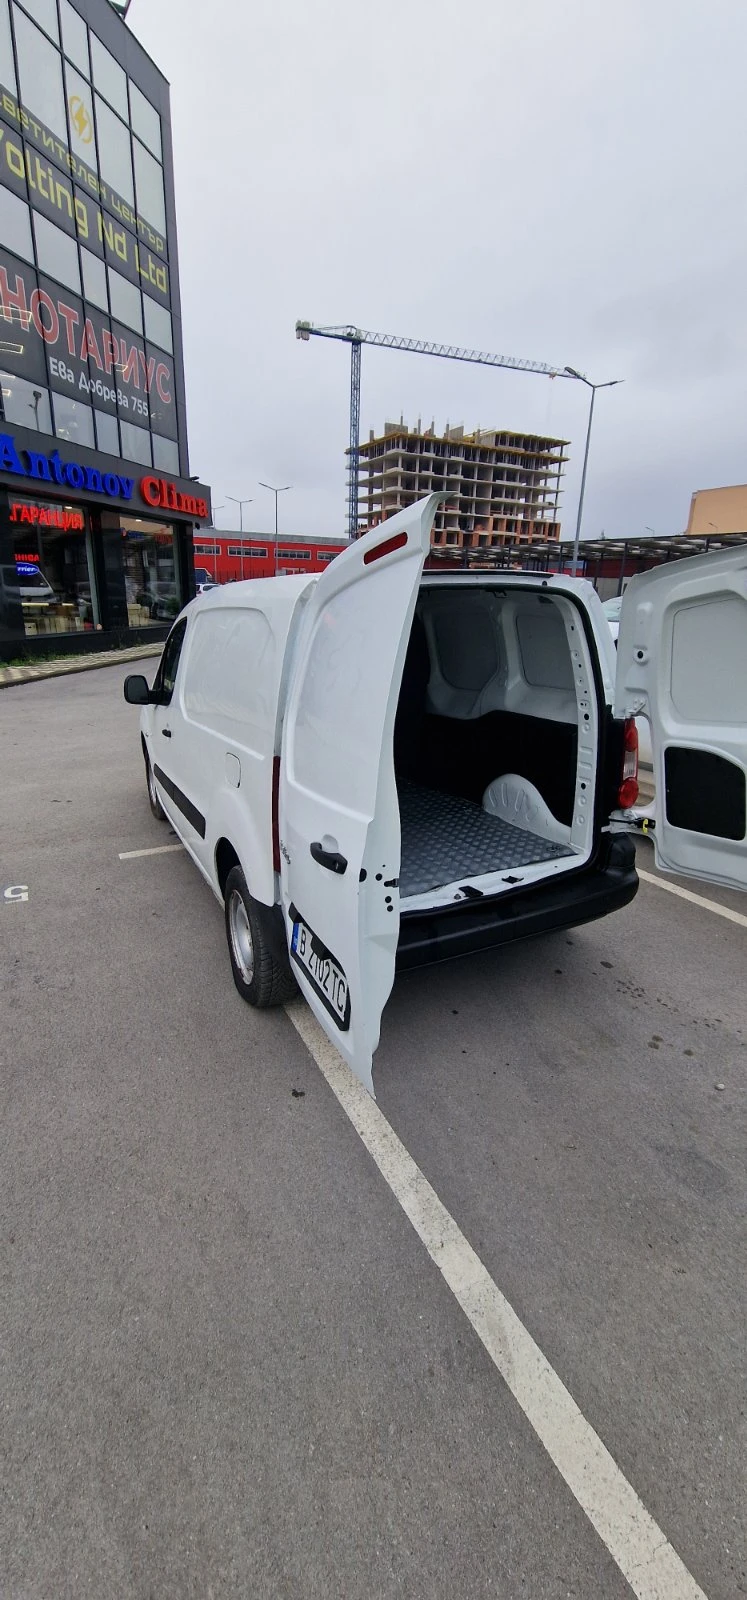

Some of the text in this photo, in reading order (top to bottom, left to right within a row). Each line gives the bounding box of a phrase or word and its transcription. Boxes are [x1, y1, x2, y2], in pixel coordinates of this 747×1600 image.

[0, 94, 106, 199] ветителен
[0, 128, 167, 294] olting Nd Ltd
[0, 265, 172, 404] НОТАРИУС
[0, 432, 209, 519] Antonov Clima
